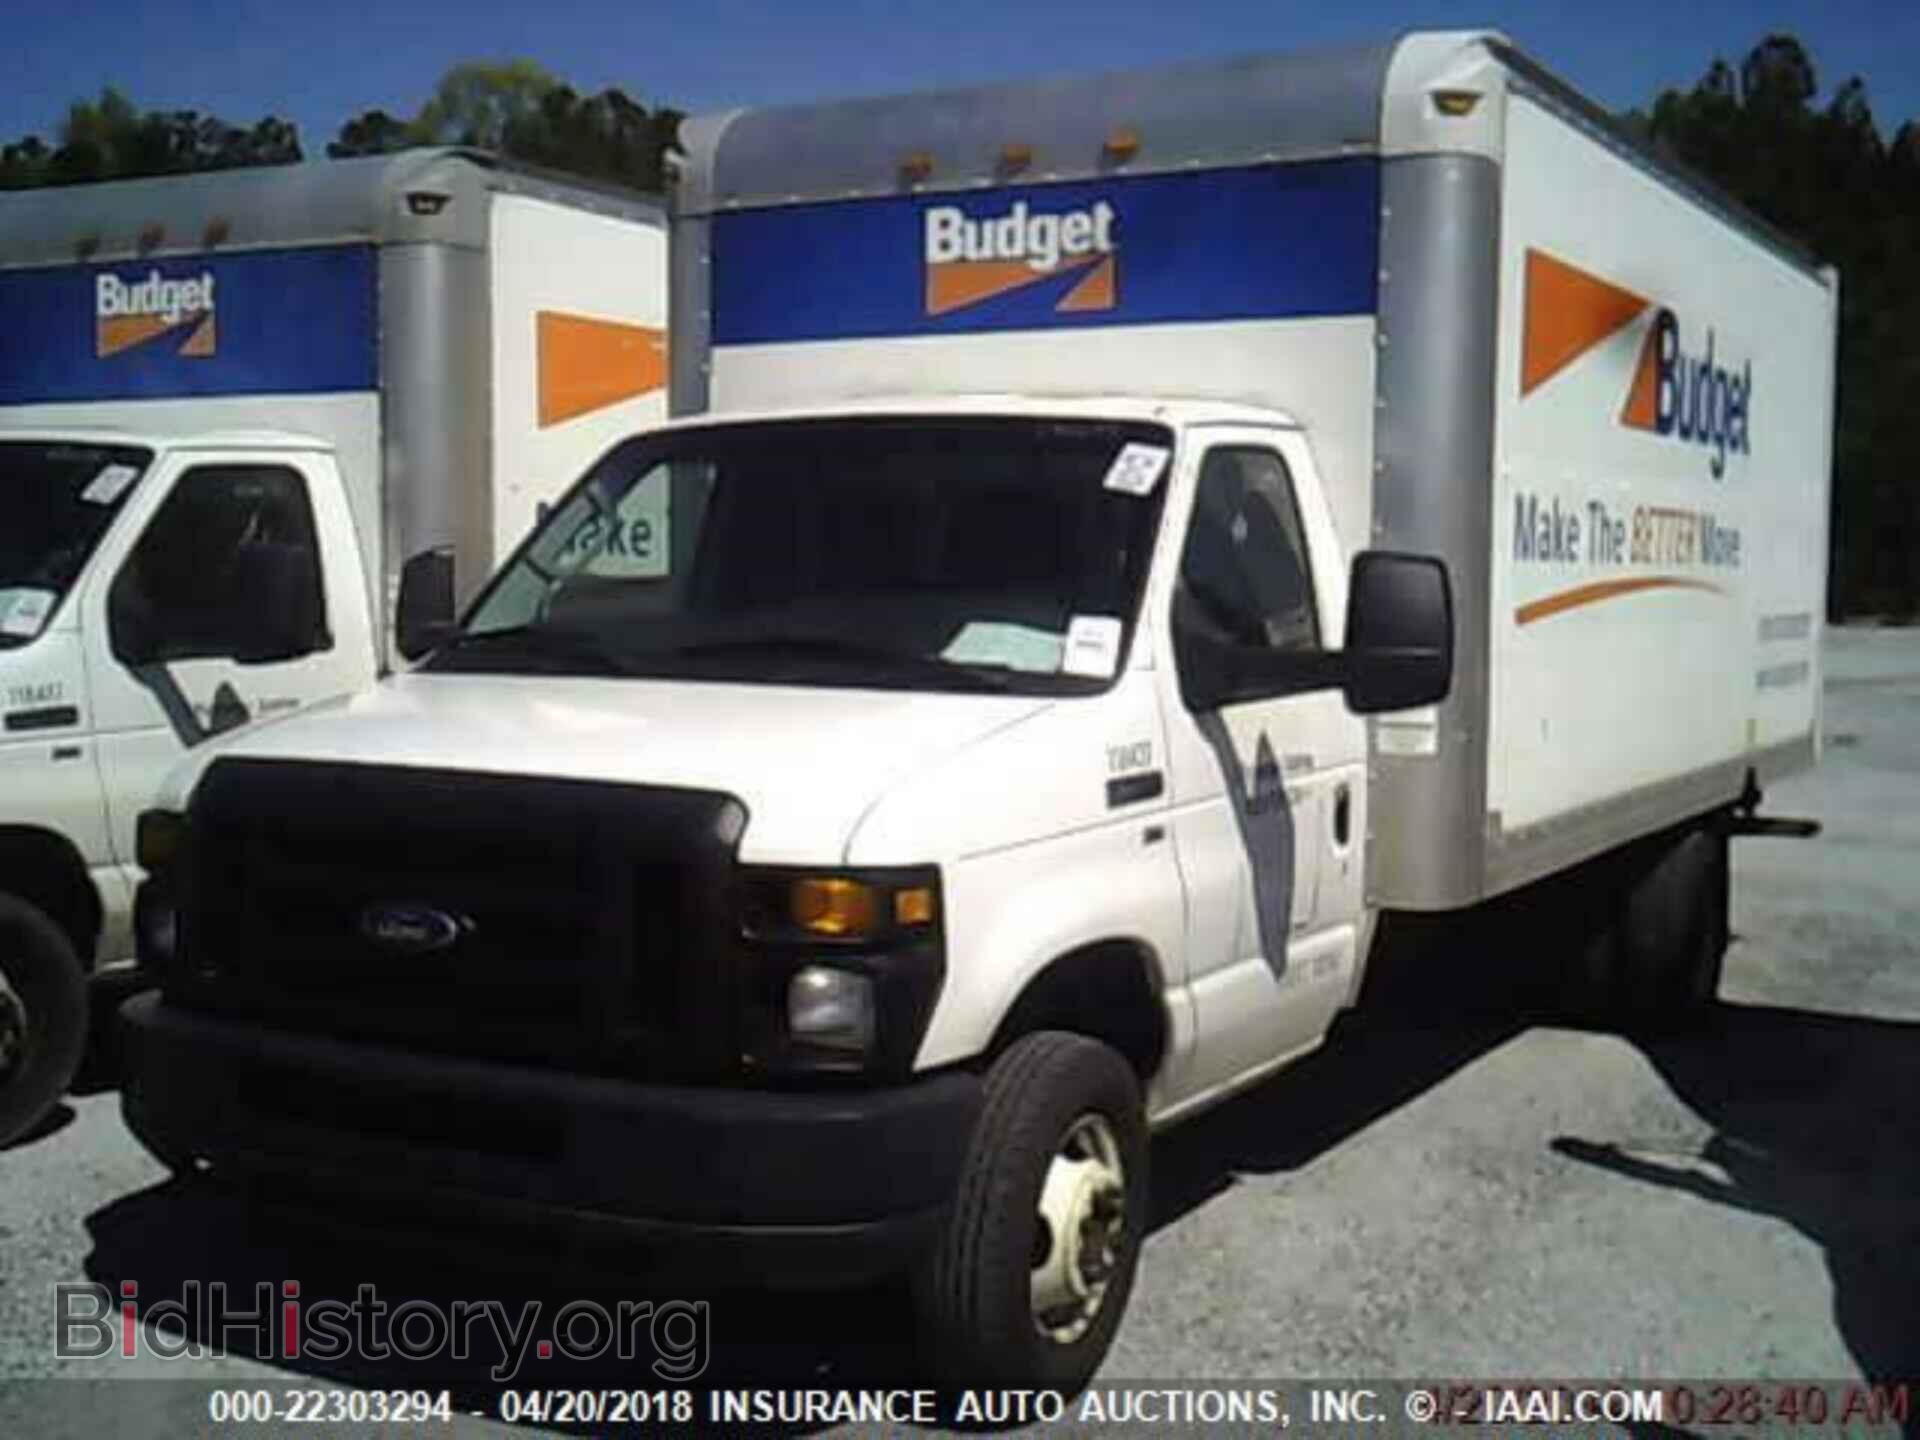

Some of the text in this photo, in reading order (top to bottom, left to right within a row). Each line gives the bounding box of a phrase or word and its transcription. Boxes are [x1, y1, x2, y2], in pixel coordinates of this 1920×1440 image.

[924, 201, 1114, 272] Budget
[96, 270, 215, 323] Budget
[1654, 306, 1751, 479] Budget
[1512, 493, 1580, 563] Make
[1586, 500, 1626, 565] The
[1630, 505, 1698, 565] BETTER
